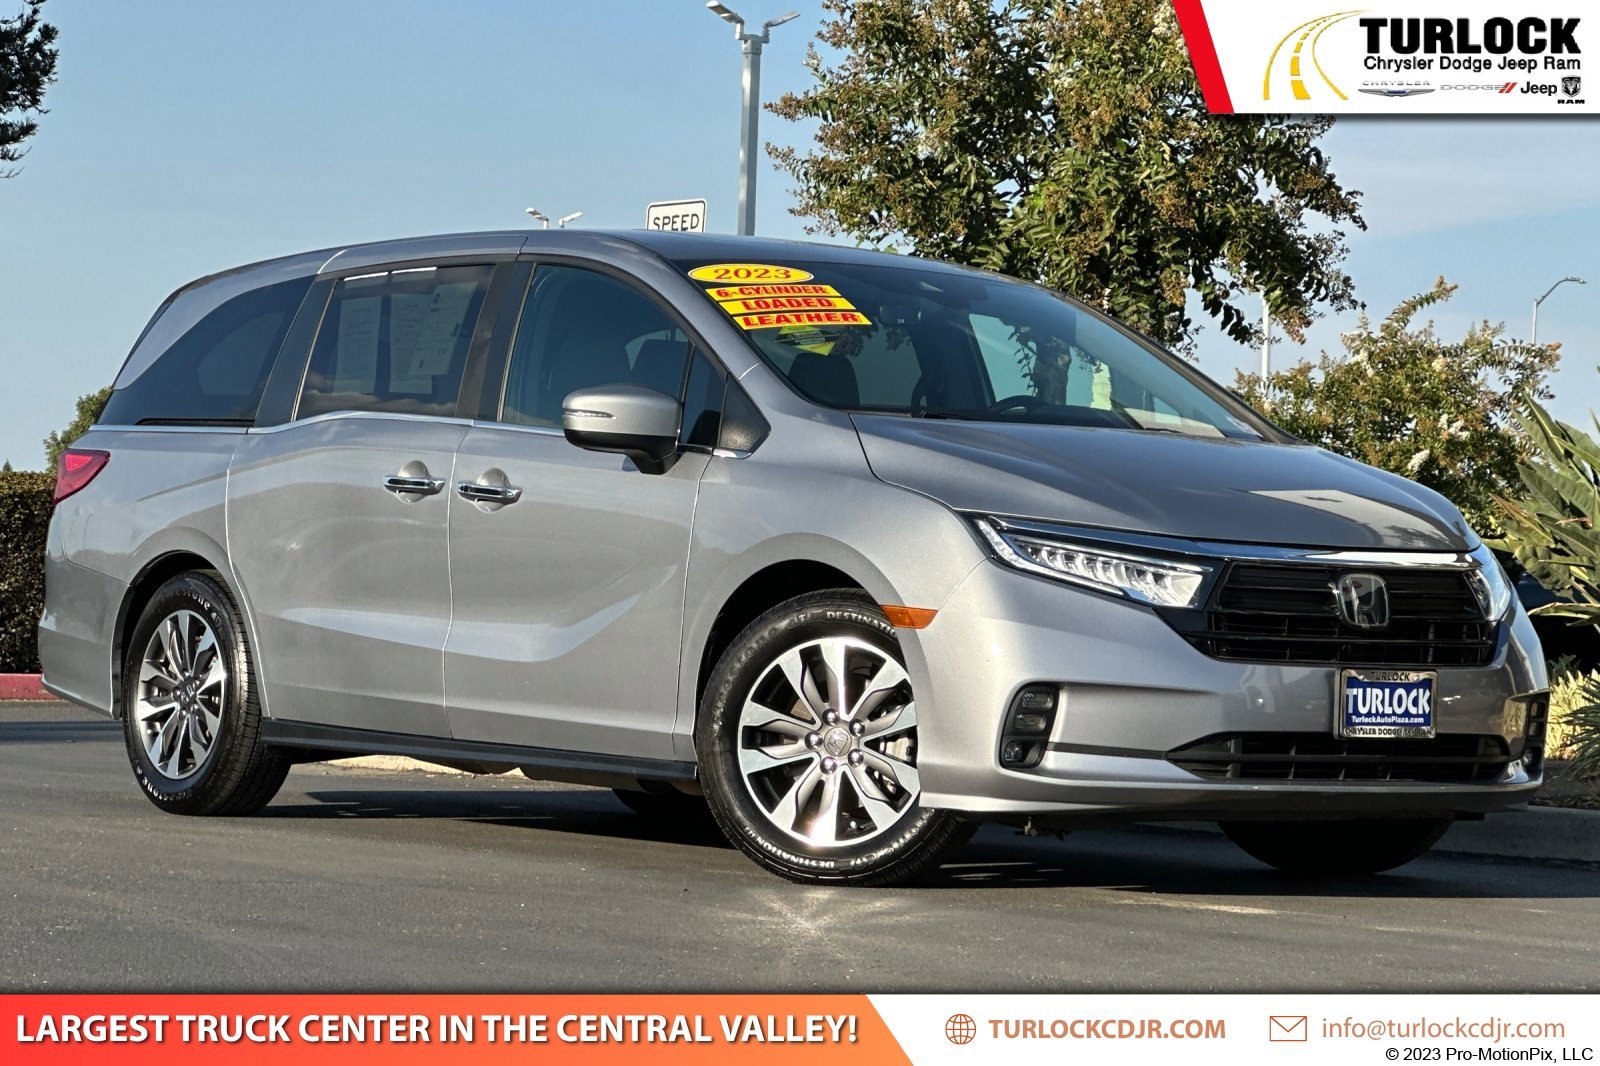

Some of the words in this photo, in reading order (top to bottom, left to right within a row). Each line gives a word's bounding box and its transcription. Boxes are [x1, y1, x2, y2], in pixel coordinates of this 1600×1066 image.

[653, 213, 700, 231] SPEED
[713, 267, 791, 280] 2023
[715, 284, 827, 298] 6-CYLINDER
[742, 298, 836, 311] LOADED
[743, 312, 860, 327] LEATHER
[826, 611, 898, 637] DESTINATIO
[1371, 671, 1411, 681] TURLOCK
[1346, 687, 1431, 715] TURLOCK
[1351, 715, 1425, 724] TurlockAutoPlaza.com
